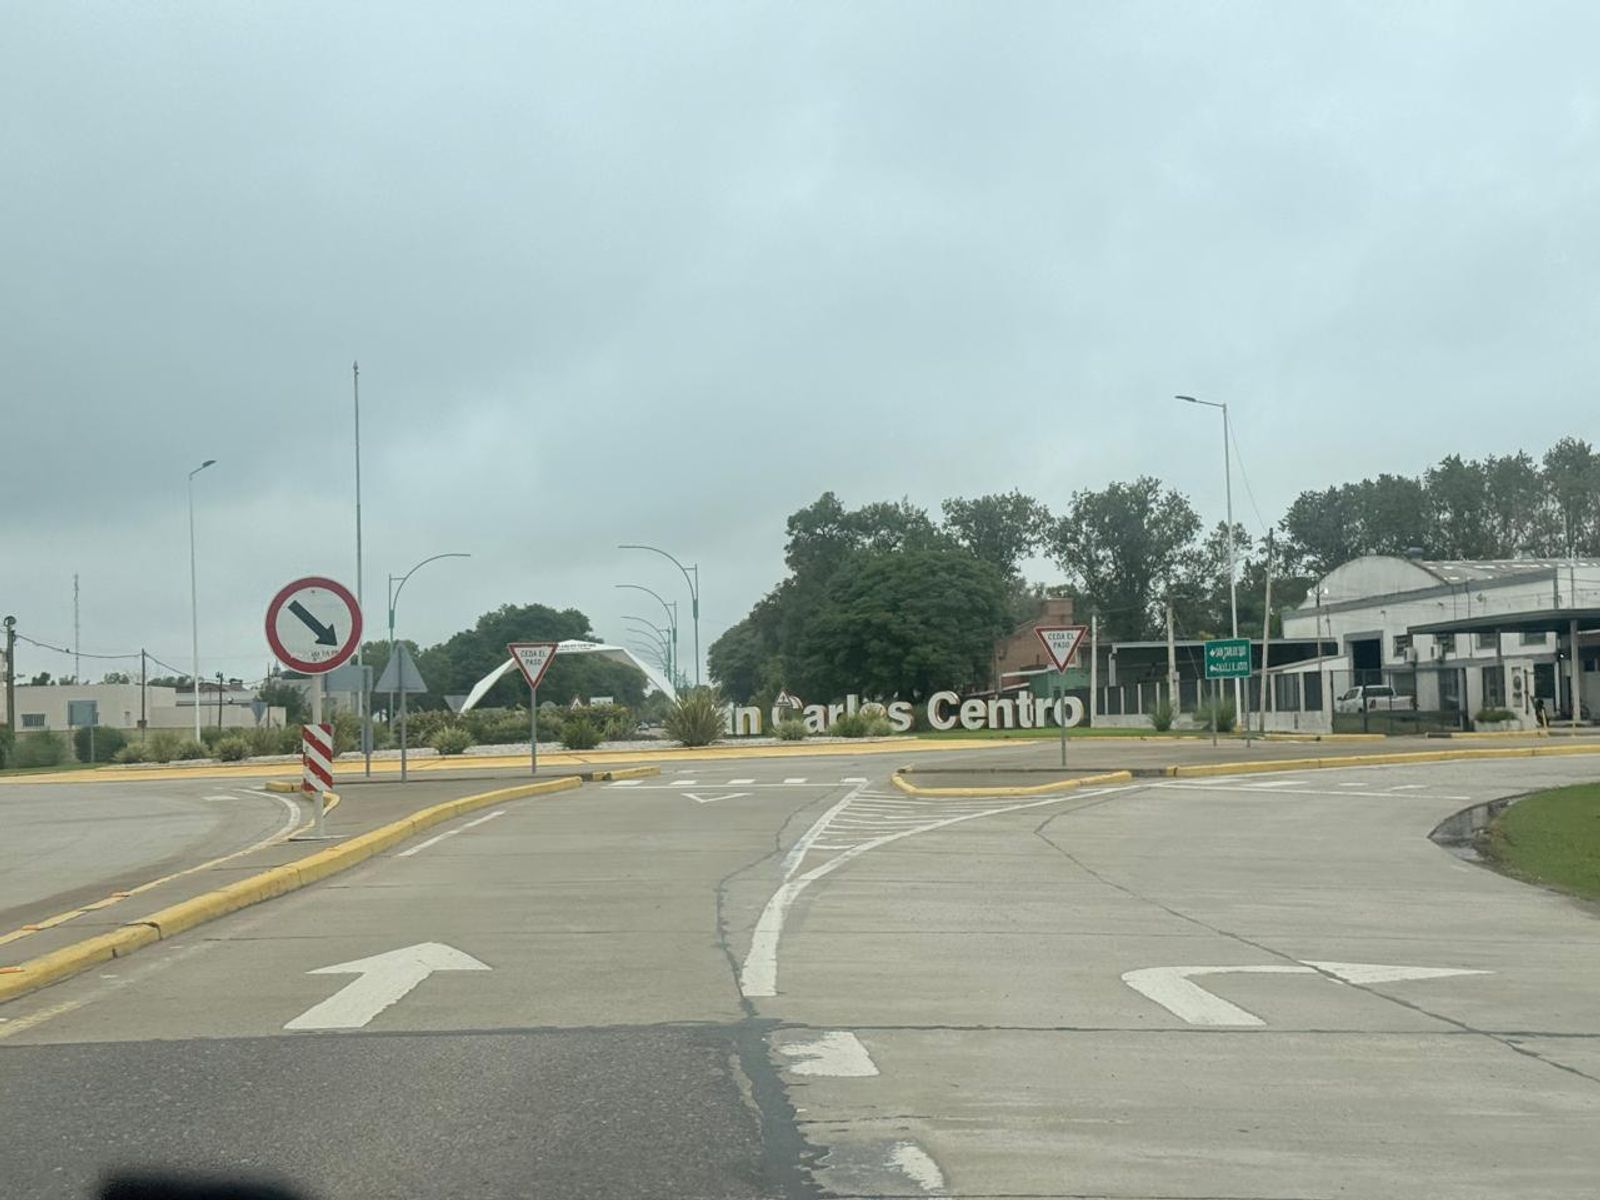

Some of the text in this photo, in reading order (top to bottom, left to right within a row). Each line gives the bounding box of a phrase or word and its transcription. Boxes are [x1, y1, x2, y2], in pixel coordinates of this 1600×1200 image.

[1047, 632, 1074, 640] CEDA EL
[520, 649, 547, 658] CEDA EL
[927, 690, 1084, 730] Centro
